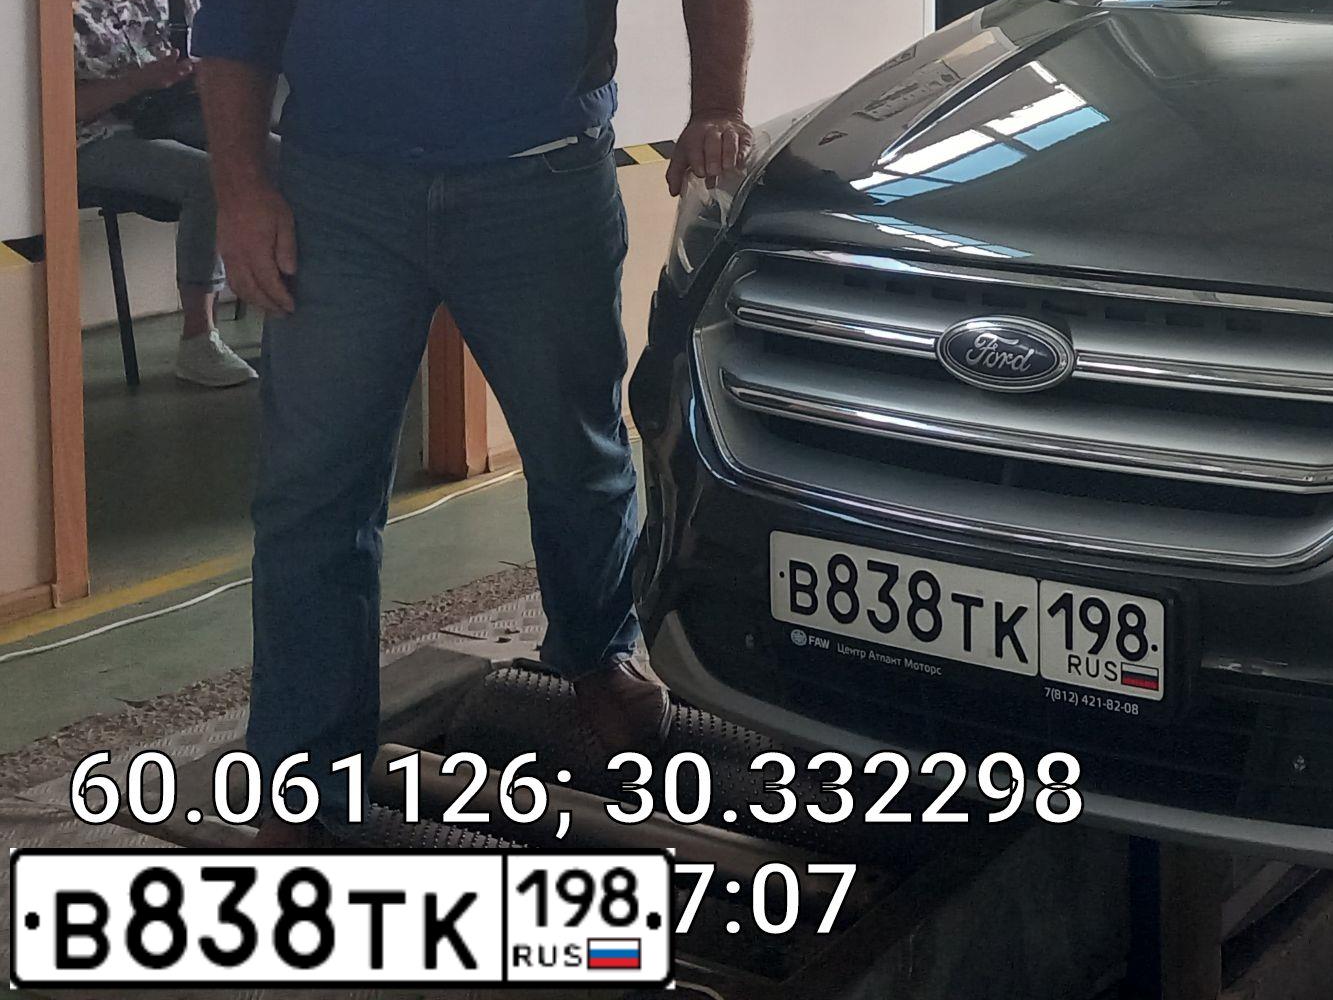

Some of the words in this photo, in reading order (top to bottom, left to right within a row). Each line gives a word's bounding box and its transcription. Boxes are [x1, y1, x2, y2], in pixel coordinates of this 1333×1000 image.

[965, 332, 1035, 373] Ford
[789, 553, 1029, 664] В838ТК
[1047, 592, 1149, 662] 198
[808, 635, 830, 650] FAW
[837, 642, 866, 659] Центр
[904, 658, 943, 676] Моторс
[1067, 653, 1118, 682] RUS
[1043, 687, 1079, 706] 7(812)
[1081, 695, 1139, 715] 421-82-08
